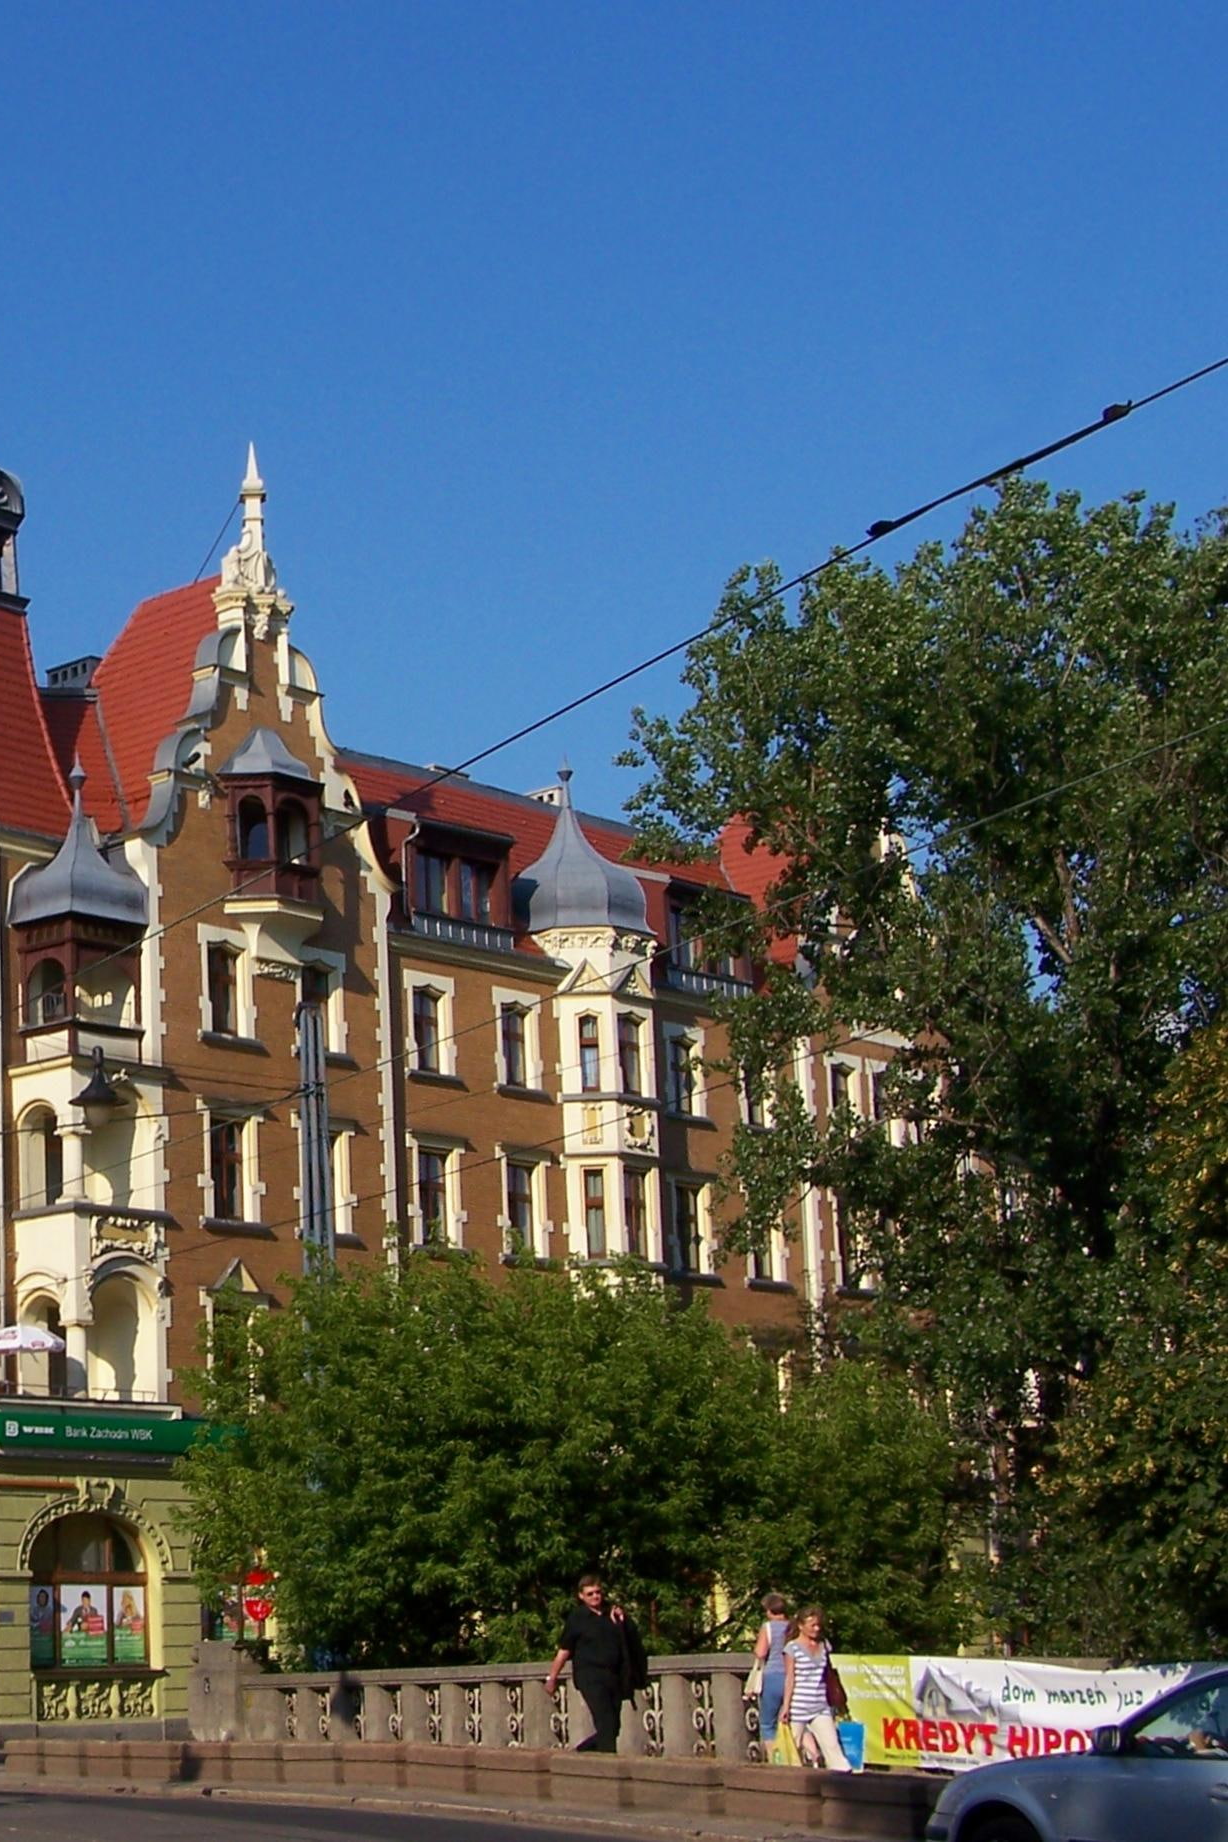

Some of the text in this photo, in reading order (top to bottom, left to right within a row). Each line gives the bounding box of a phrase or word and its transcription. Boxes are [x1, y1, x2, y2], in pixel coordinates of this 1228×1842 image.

[65, 1425, 88, 1439] Bank
[89, 1425, 130, 1440] Zachodni
[130, 1428, 153, 1441] WBK
[1001, 1675, 1036, 1704] dom
[882, 1716, 998, 1757] KREDYT
